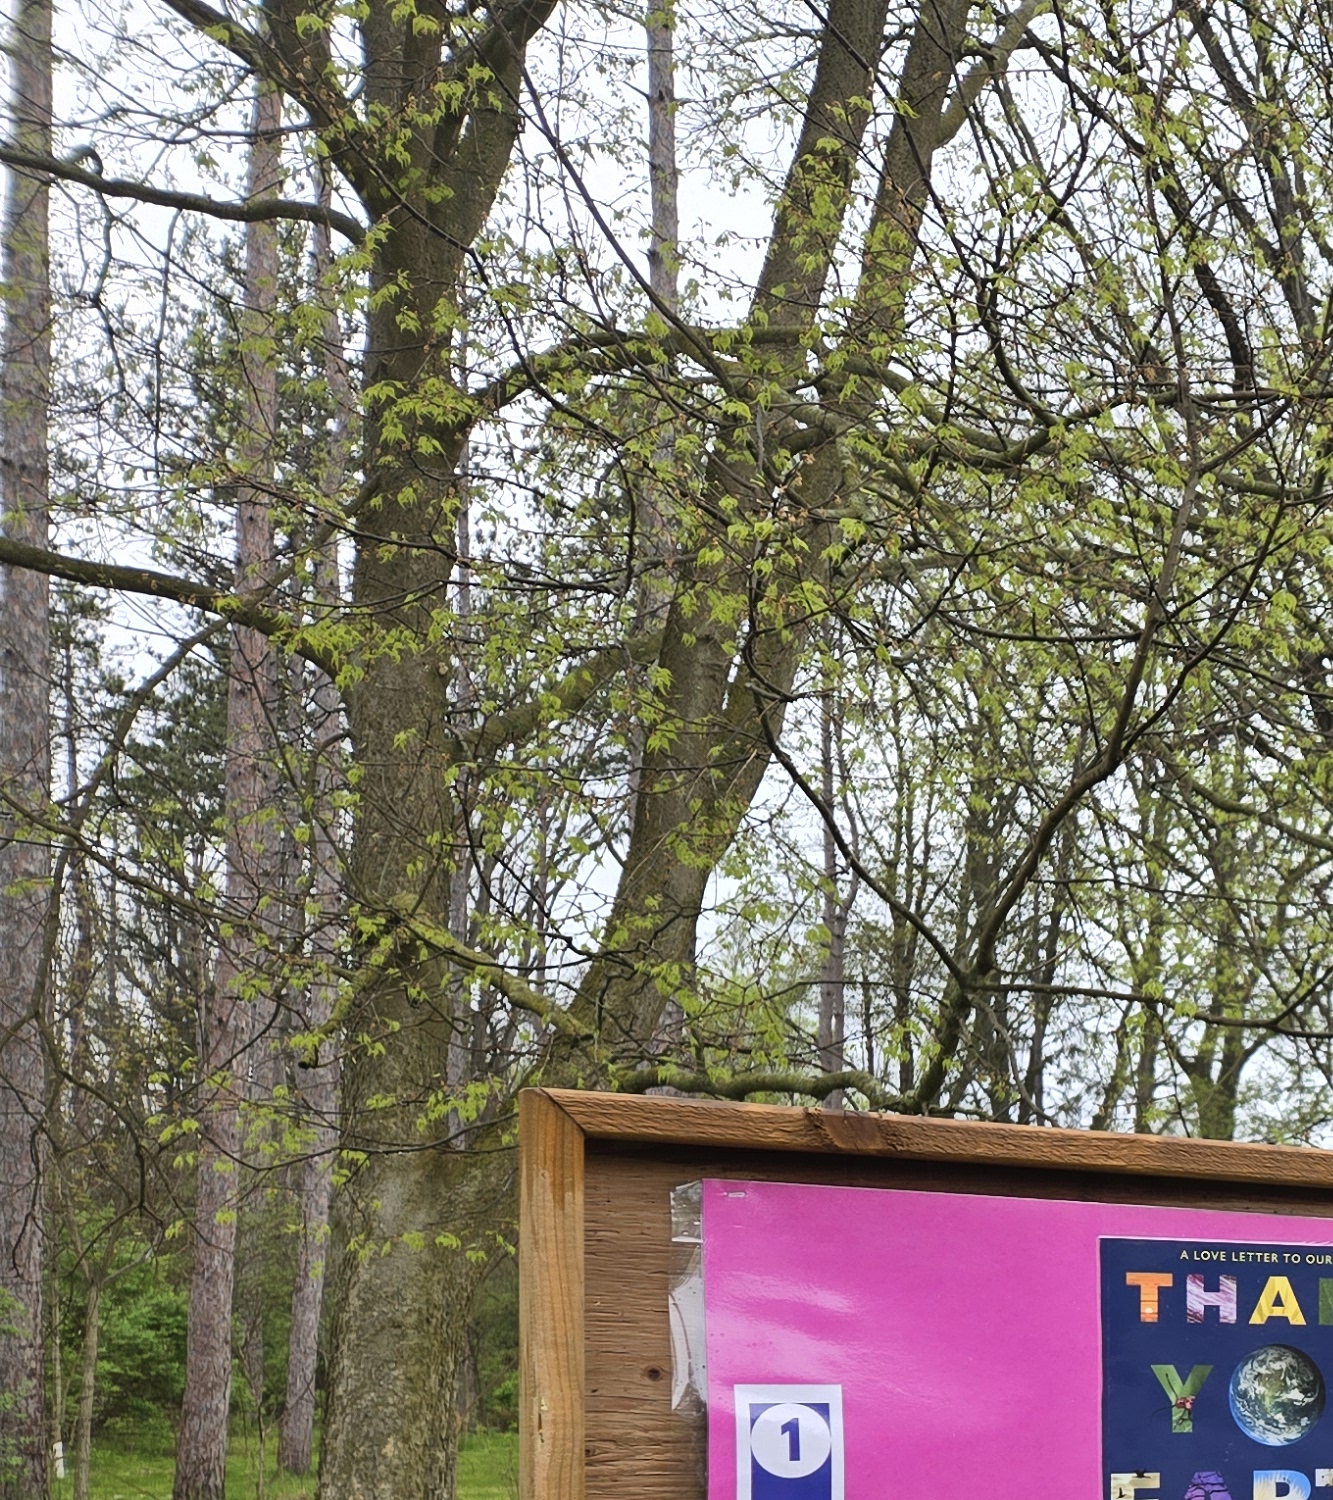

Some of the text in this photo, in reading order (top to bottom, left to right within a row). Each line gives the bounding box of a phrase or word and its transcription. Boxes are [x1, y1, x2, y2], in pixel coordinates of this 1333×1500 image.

[1180, 1251, 1189, 1260] A
[1193, 1251, 1226, 1261] LOVE
[1232, 1252, 1278, 1262] LETTER
[1283, 1254, 1300, 1264] TO
[1306, 1254, 1332, 1264] OUR
[780, 1417, 801, 1462] 1
